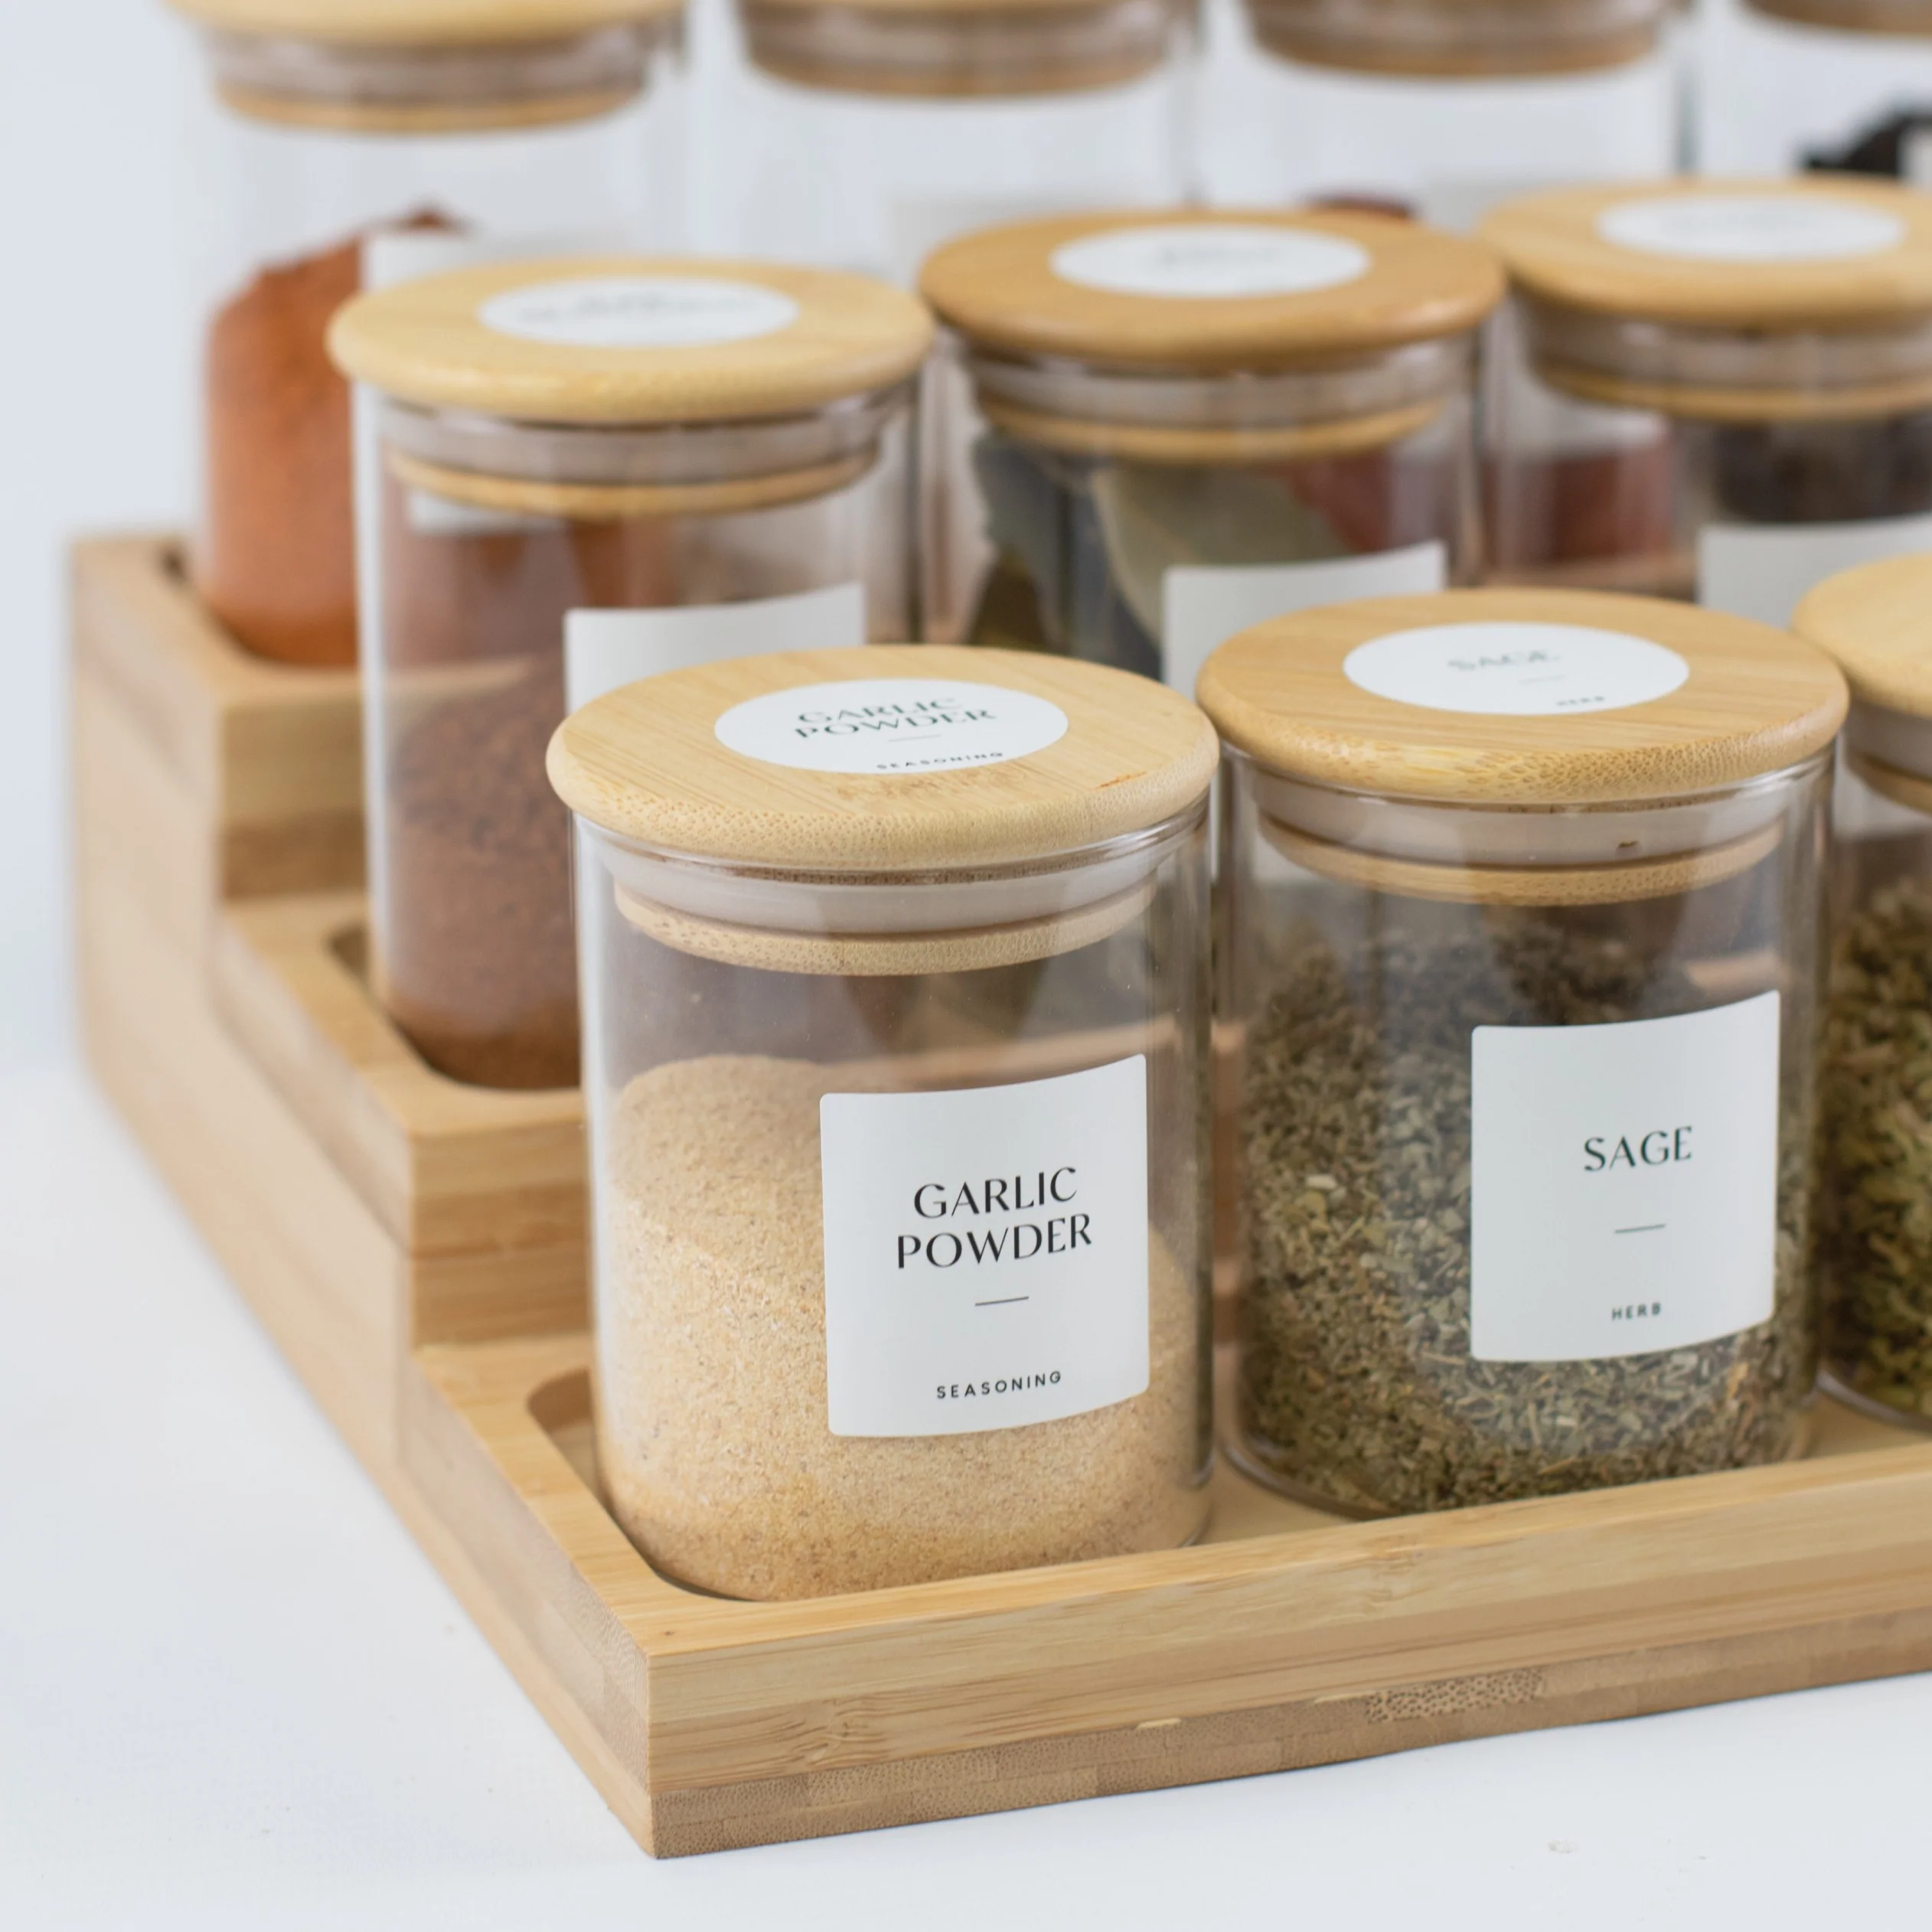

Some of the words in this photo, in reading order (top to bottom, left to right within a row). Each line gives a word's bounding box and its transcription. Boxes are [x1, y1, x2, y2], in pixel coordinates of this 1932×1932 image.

[795, 708, 997, 739] POWDER
[798, 697, 963, 724] GARLIC
[876, 752, 1004, 769] SEASONING
[1583, 1125, 1693, 1173] SAGE
[913, 1166, 1077, 1219] GARLIC
[897, 1212, 1092, 1270] POWDER
[1611, 1302, 1662, 1320] HERB
[936, 1370, 1062, 1400] SEASONING
